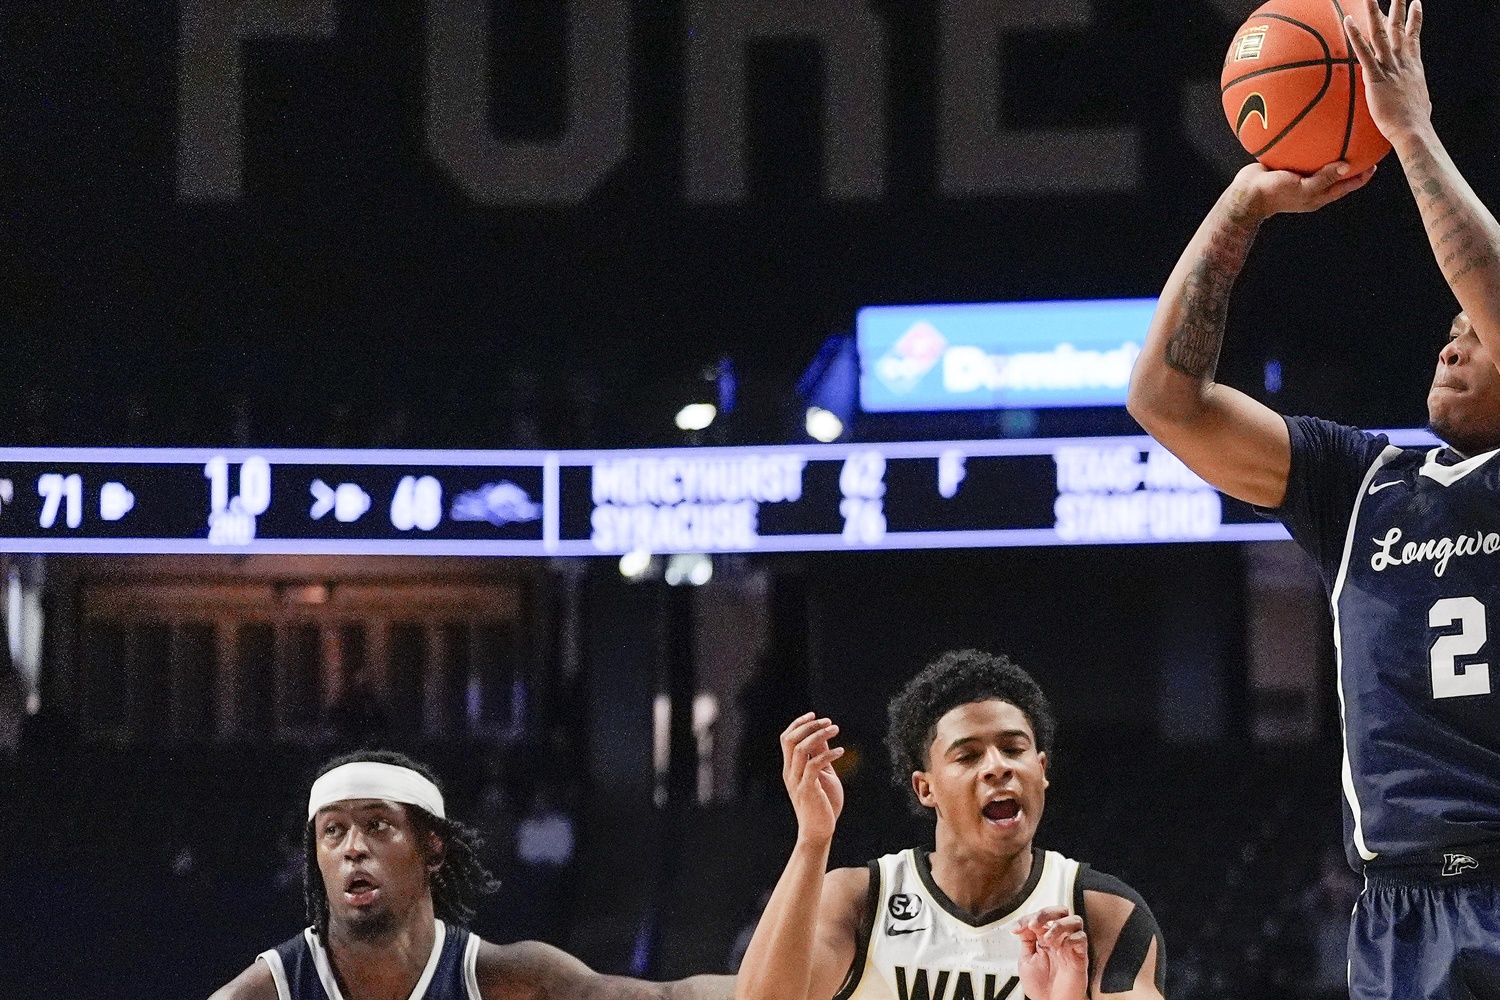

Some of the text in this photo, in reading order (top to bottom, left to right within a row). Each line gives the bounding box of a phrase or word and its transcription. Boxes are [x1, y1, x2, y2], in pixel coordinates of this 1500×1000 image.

[38, 473, 82, 528] 71
[1054, 491, 1221, 541] STANFORD
[1428, 597, 1491, 699] 2
[891, 893, 920, 917] 54
